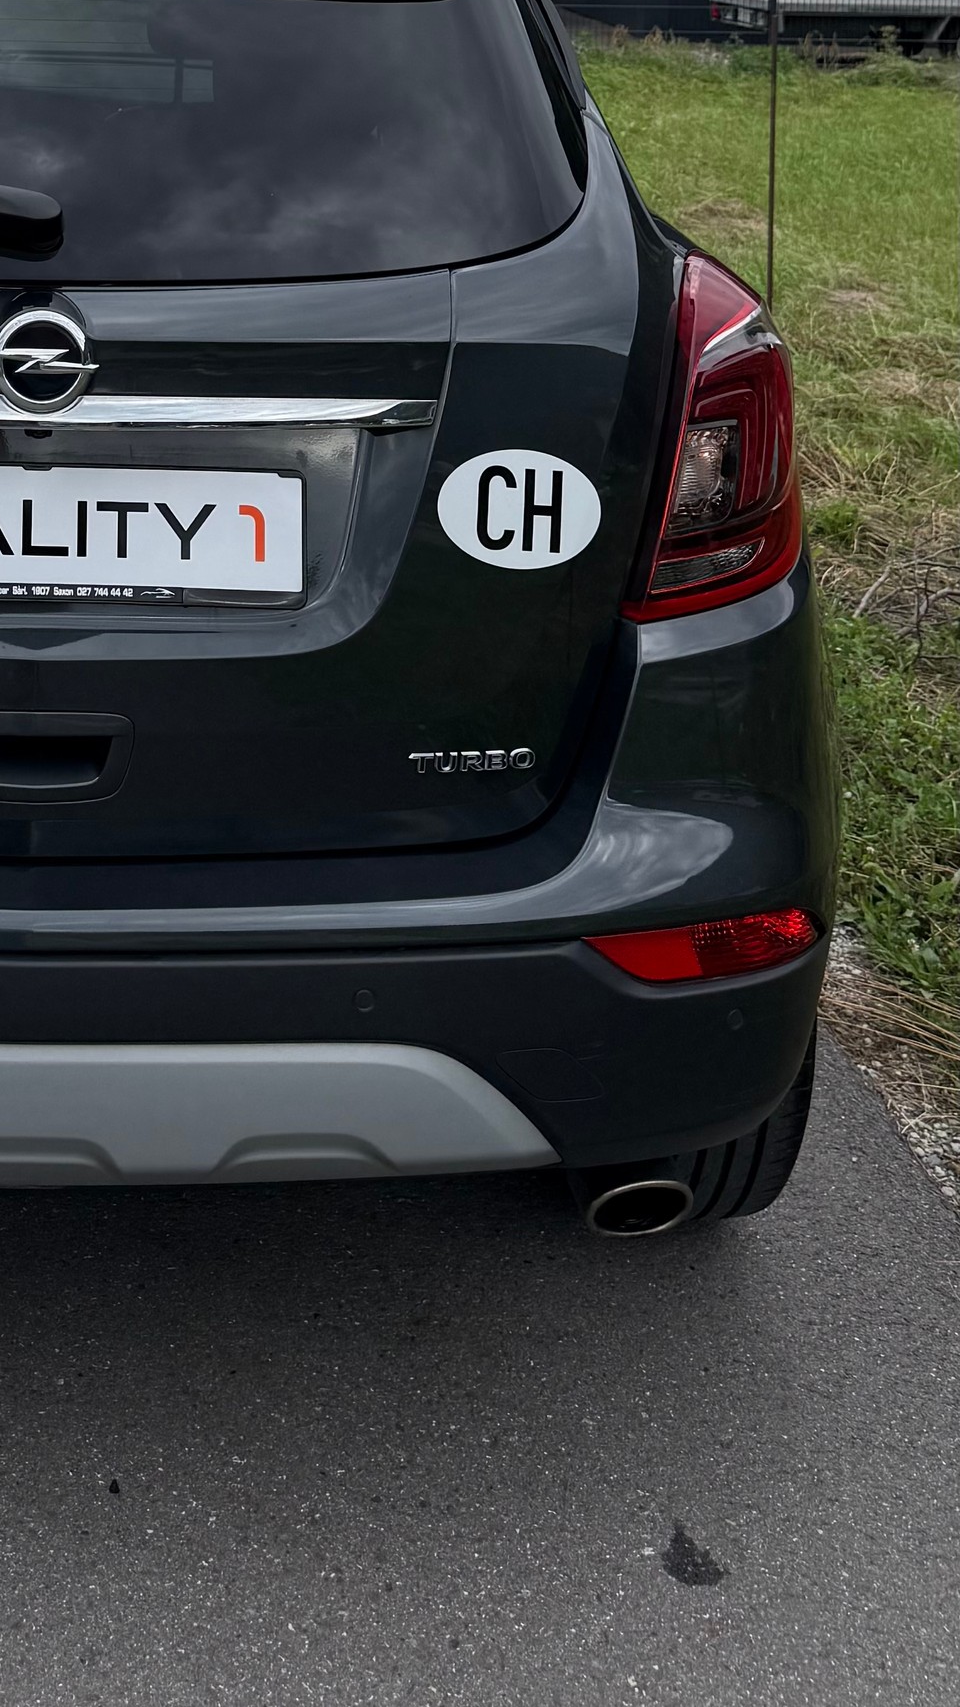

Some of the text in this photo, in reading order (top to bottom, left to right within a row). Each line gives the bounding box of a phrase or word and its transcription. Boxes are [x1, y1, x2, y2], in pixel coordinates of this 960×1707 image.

[476, 465, 564, 554] CH
[239, 504, 266, 562] 1
[76, 586, 92, 597] 027
[94, 587, 109, 597] 744
[110, 587, 121, 597] 44
[122, 588, 134, 597] 42
[408, 747, 536, 773] TURBO
